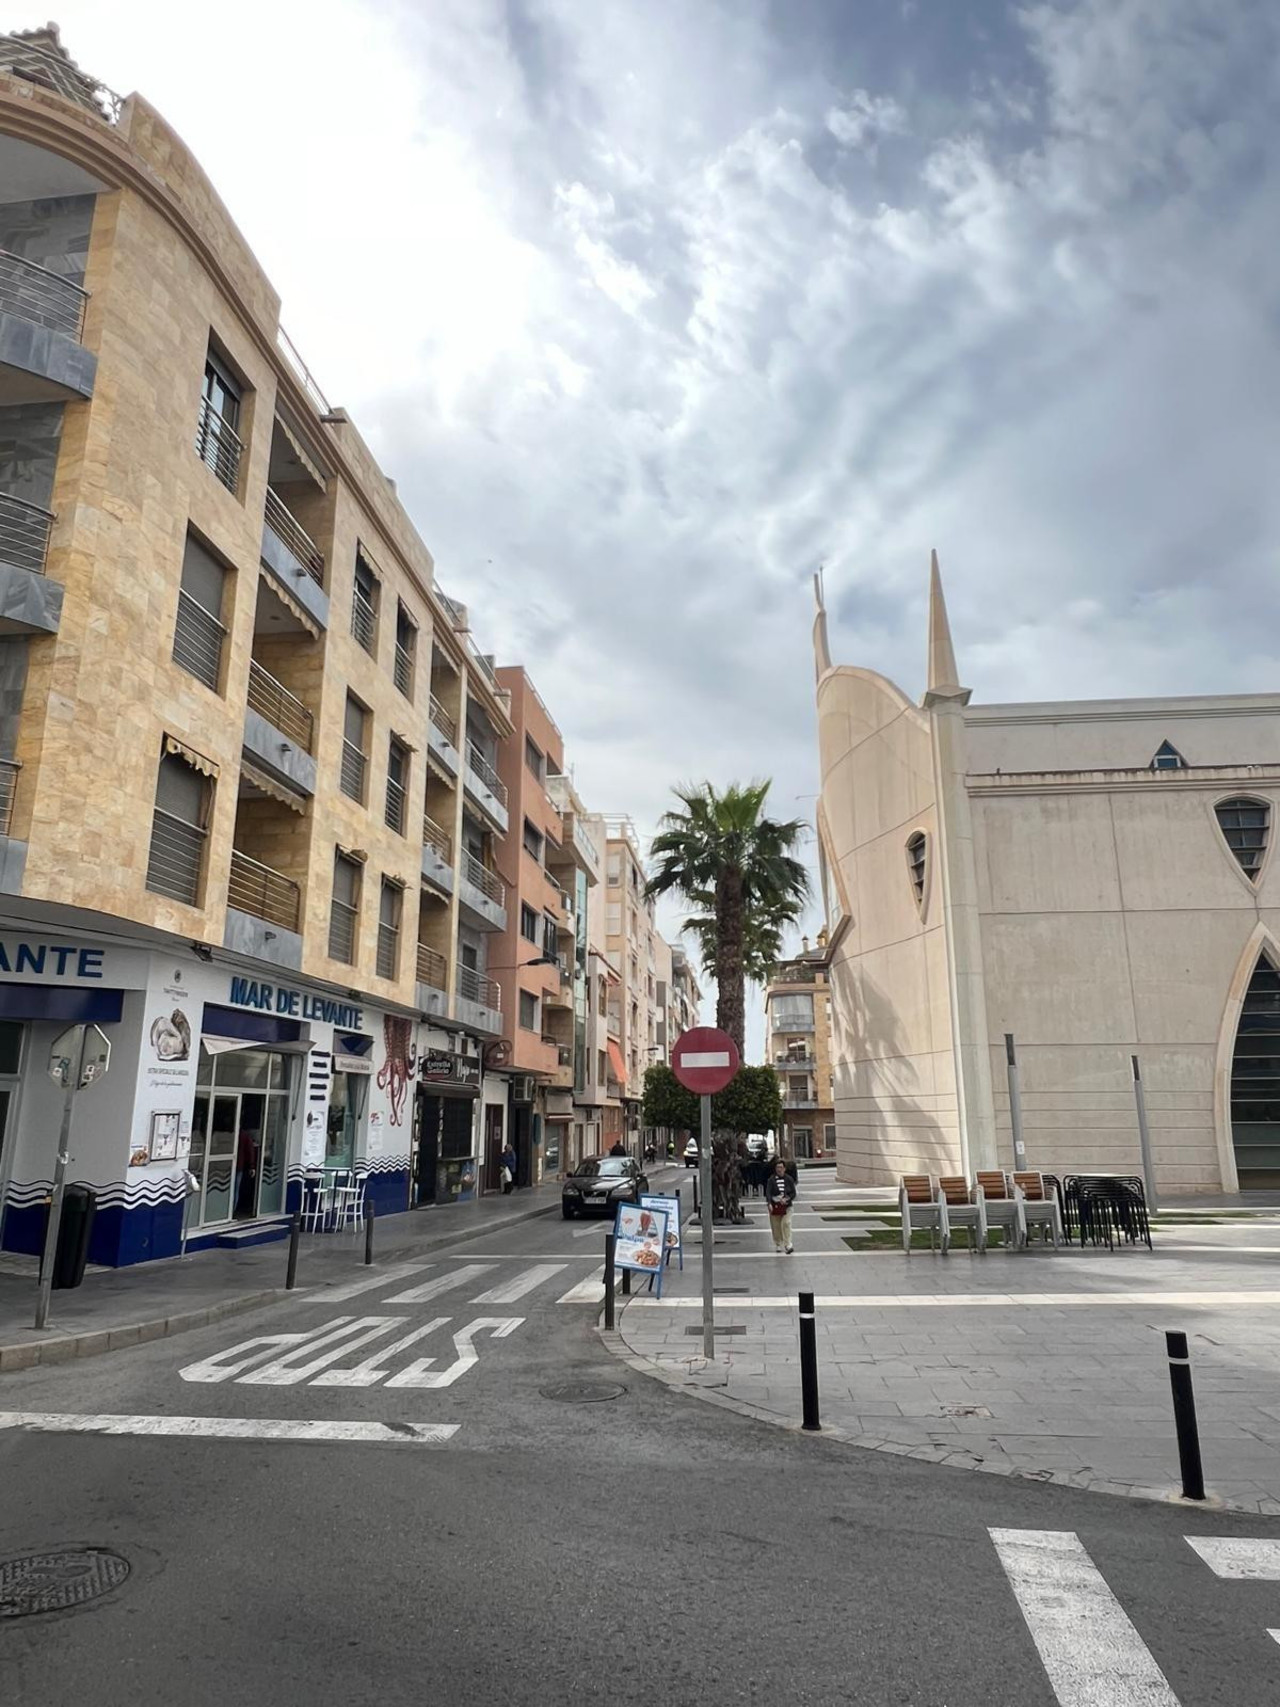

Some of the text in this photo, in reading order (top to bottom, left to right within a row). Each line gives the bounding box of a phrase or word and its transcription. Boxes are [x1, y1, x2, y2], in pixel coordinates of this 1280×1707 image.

[230, 976, 364, 1031] MAR DE LEVANTE
[178, 1316, 527, 1388] STOP
